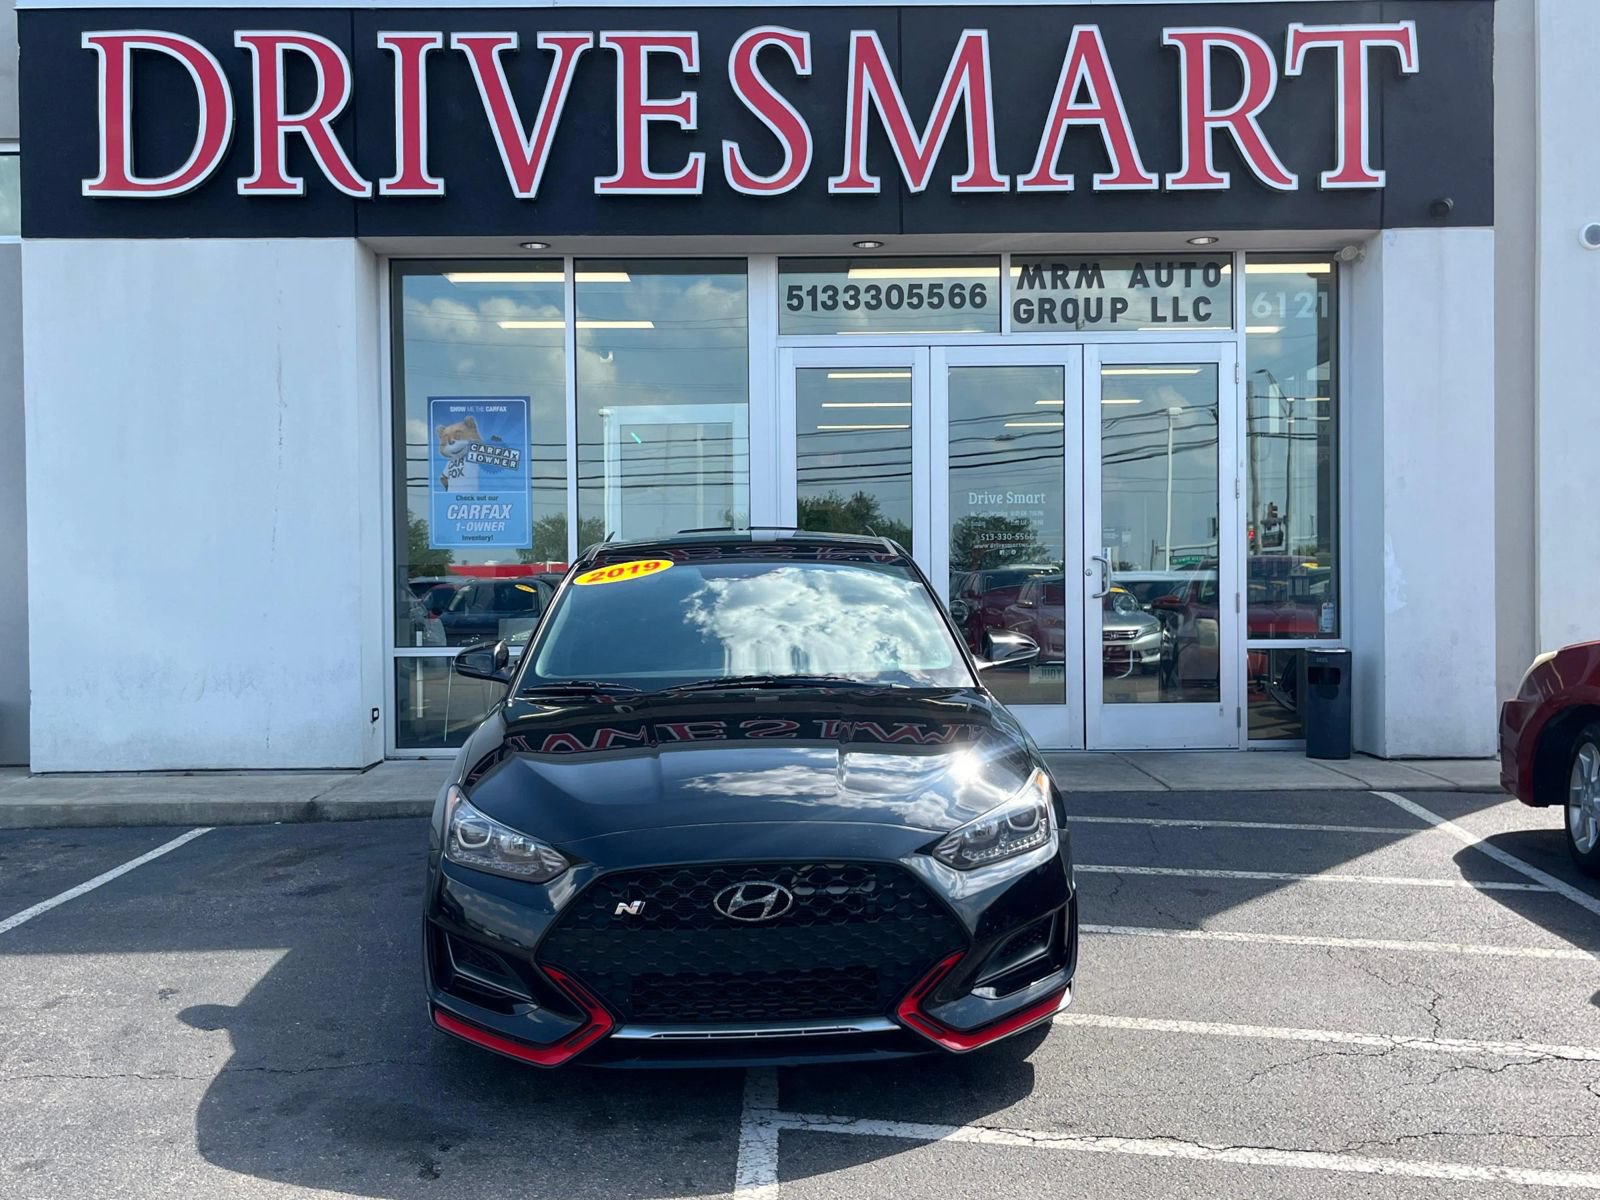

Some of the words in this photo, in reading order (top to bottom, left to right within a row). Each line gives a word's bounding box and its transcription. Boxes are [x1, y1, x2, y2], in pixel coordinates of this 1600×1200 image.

[81, 22, 1420, 199] DRIVESMART
[1016, 262, 1105, 290] MRM
[1127, 261, 1222, 289] AUTO
[786, 283, 988, 312] 5133305566
[1251, 291, 1329, 319] 6121
[1013, 296, 1129, 324] GROUP
[1151, 295, 1213, 323] LLC
[471, 444, 520, 461] CARFAX
[448, 467, 465, 479] FOX
[968, 492, 1003, 505] Drive
[1006, 491, 1046, 505] Smart
[447, 504, 513, 520] CARFAX
[456, 521, 505, 532] 1-OWNER
[586, 561, 661, 583] 2019
